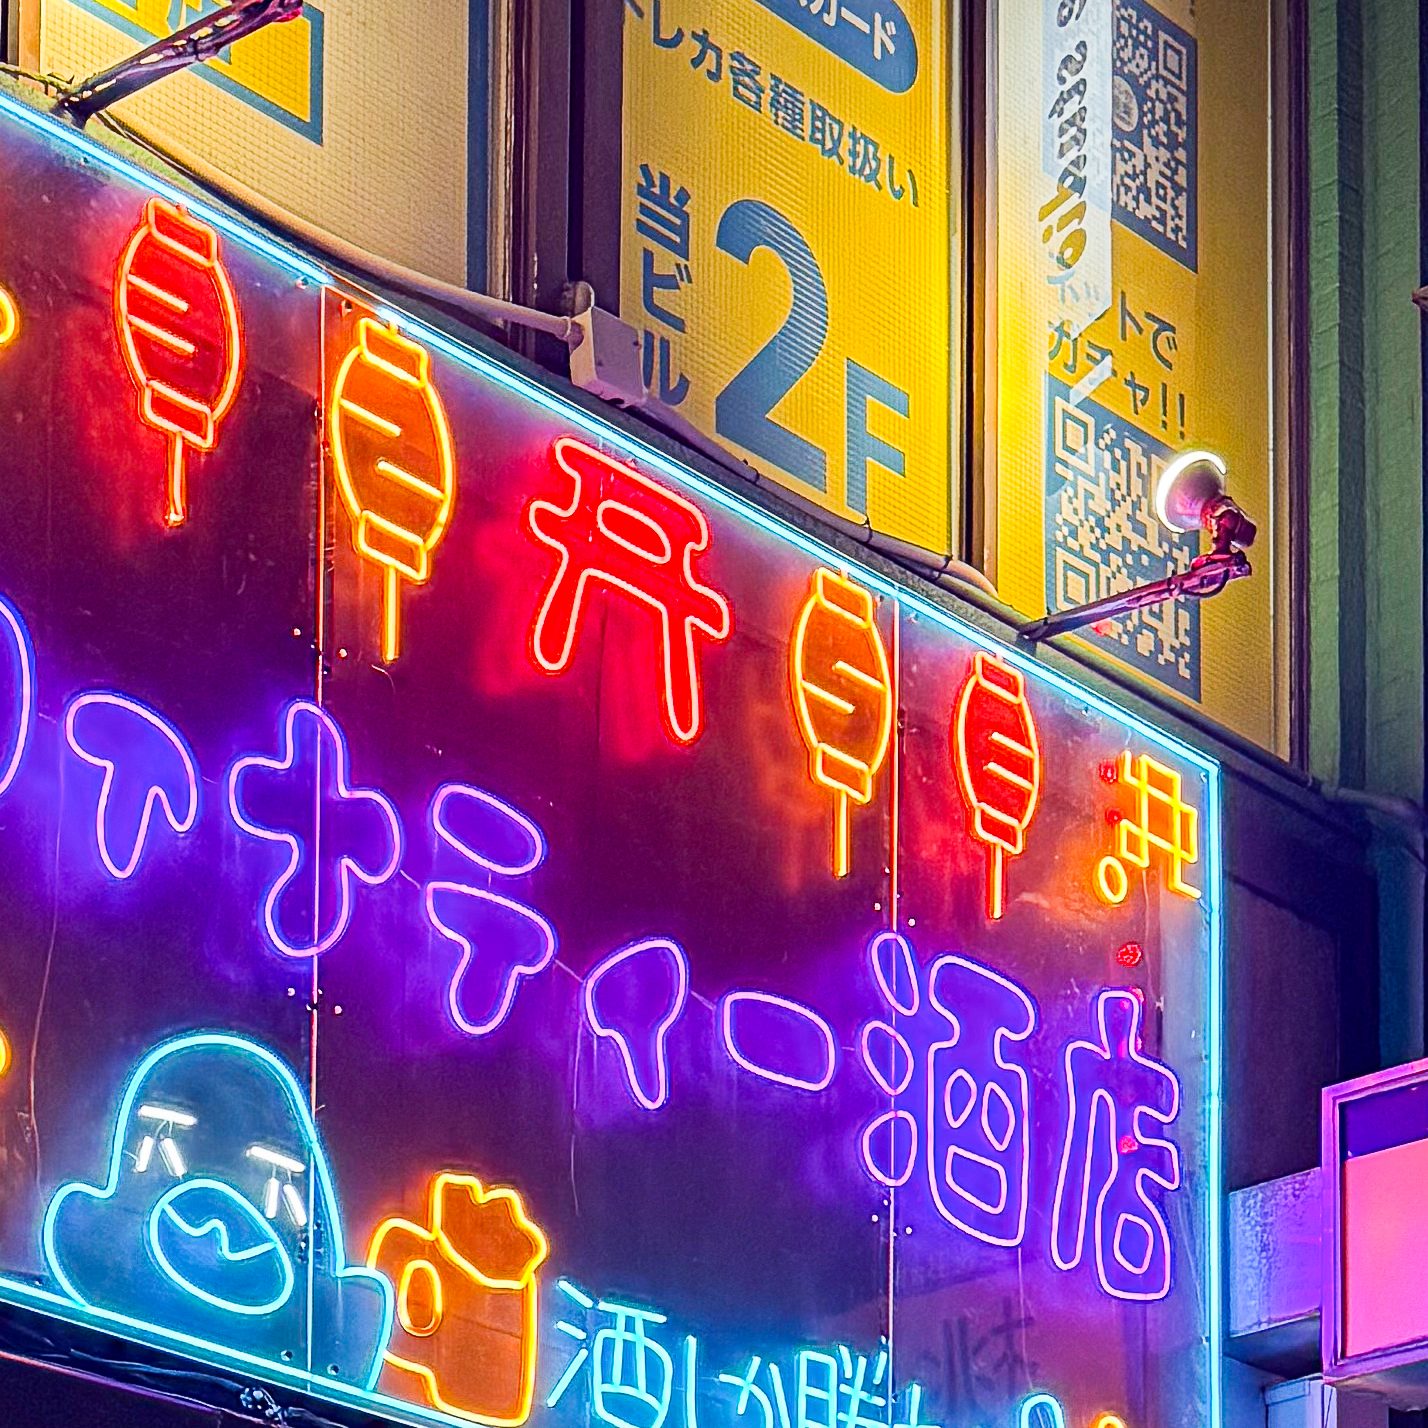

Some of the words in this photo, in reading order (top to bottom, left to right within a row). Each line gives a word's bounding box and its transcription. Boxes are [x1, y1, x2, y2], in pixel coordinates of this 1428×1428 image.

[636, 163, 692, 406] 当ビル
[716, 199, 909, 517] 2F
